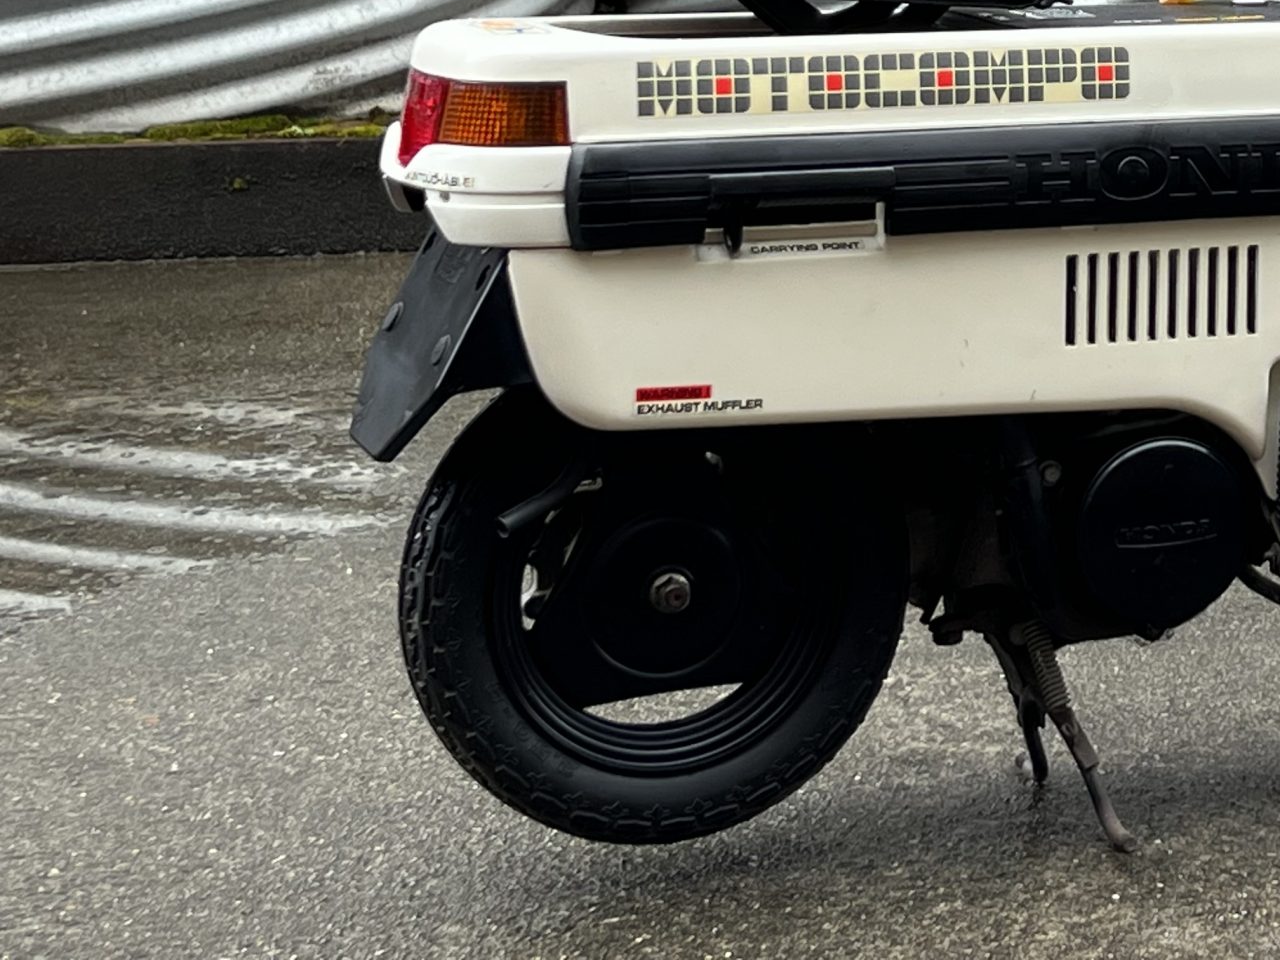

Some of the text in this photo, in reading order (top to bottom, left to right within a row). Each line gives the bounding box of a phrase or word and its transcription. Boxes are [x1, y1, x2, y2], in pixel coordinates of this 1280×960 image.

[637, 46, 1130, 116] MOTOCOMPO
[750, 240, 860, 255] CARRYING POINT
[637, 399, 763, 415] EXHAUST MUFFLER
[1119, 518, 1211, 540] HONDA
